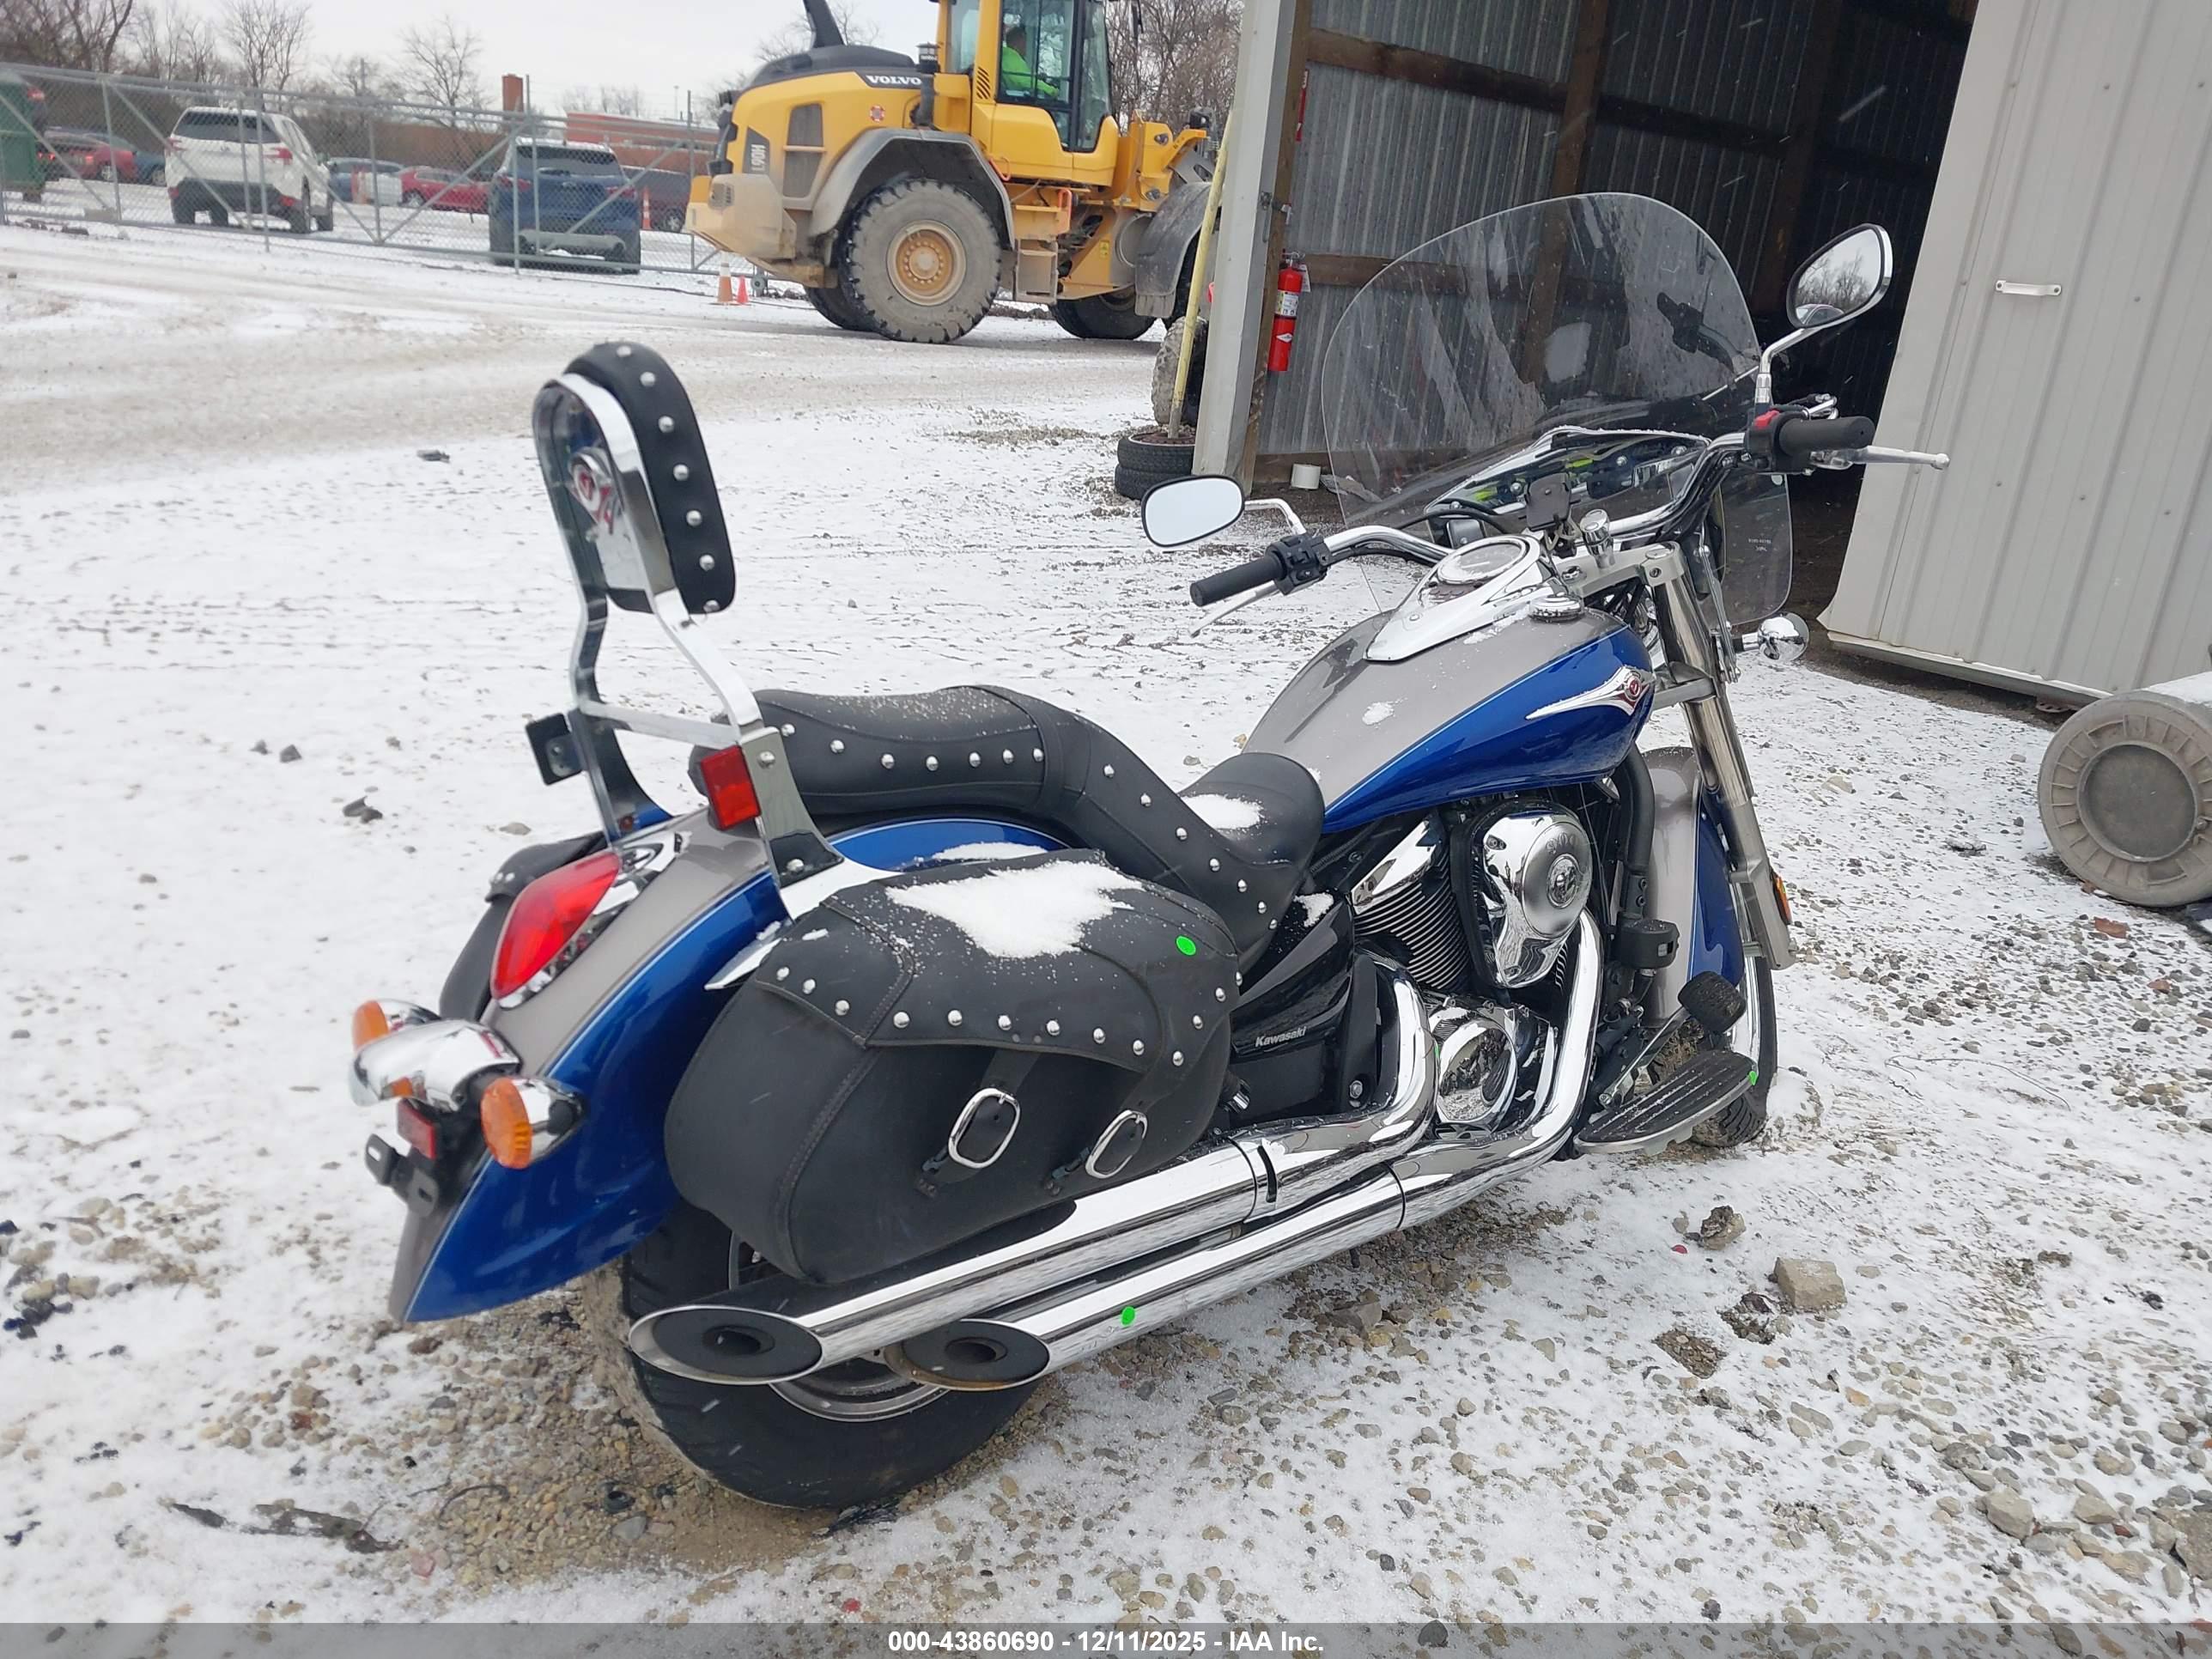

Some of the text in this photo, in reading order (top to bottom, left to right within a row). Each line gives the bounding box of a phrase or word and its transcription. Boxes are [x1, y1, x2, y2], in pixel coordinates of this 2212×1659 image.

[866, 75, 921, 86] VOLVO
[750, 143, 766, 172] L90H
[1255, 1026, 1307, 1047] Kawasaki
